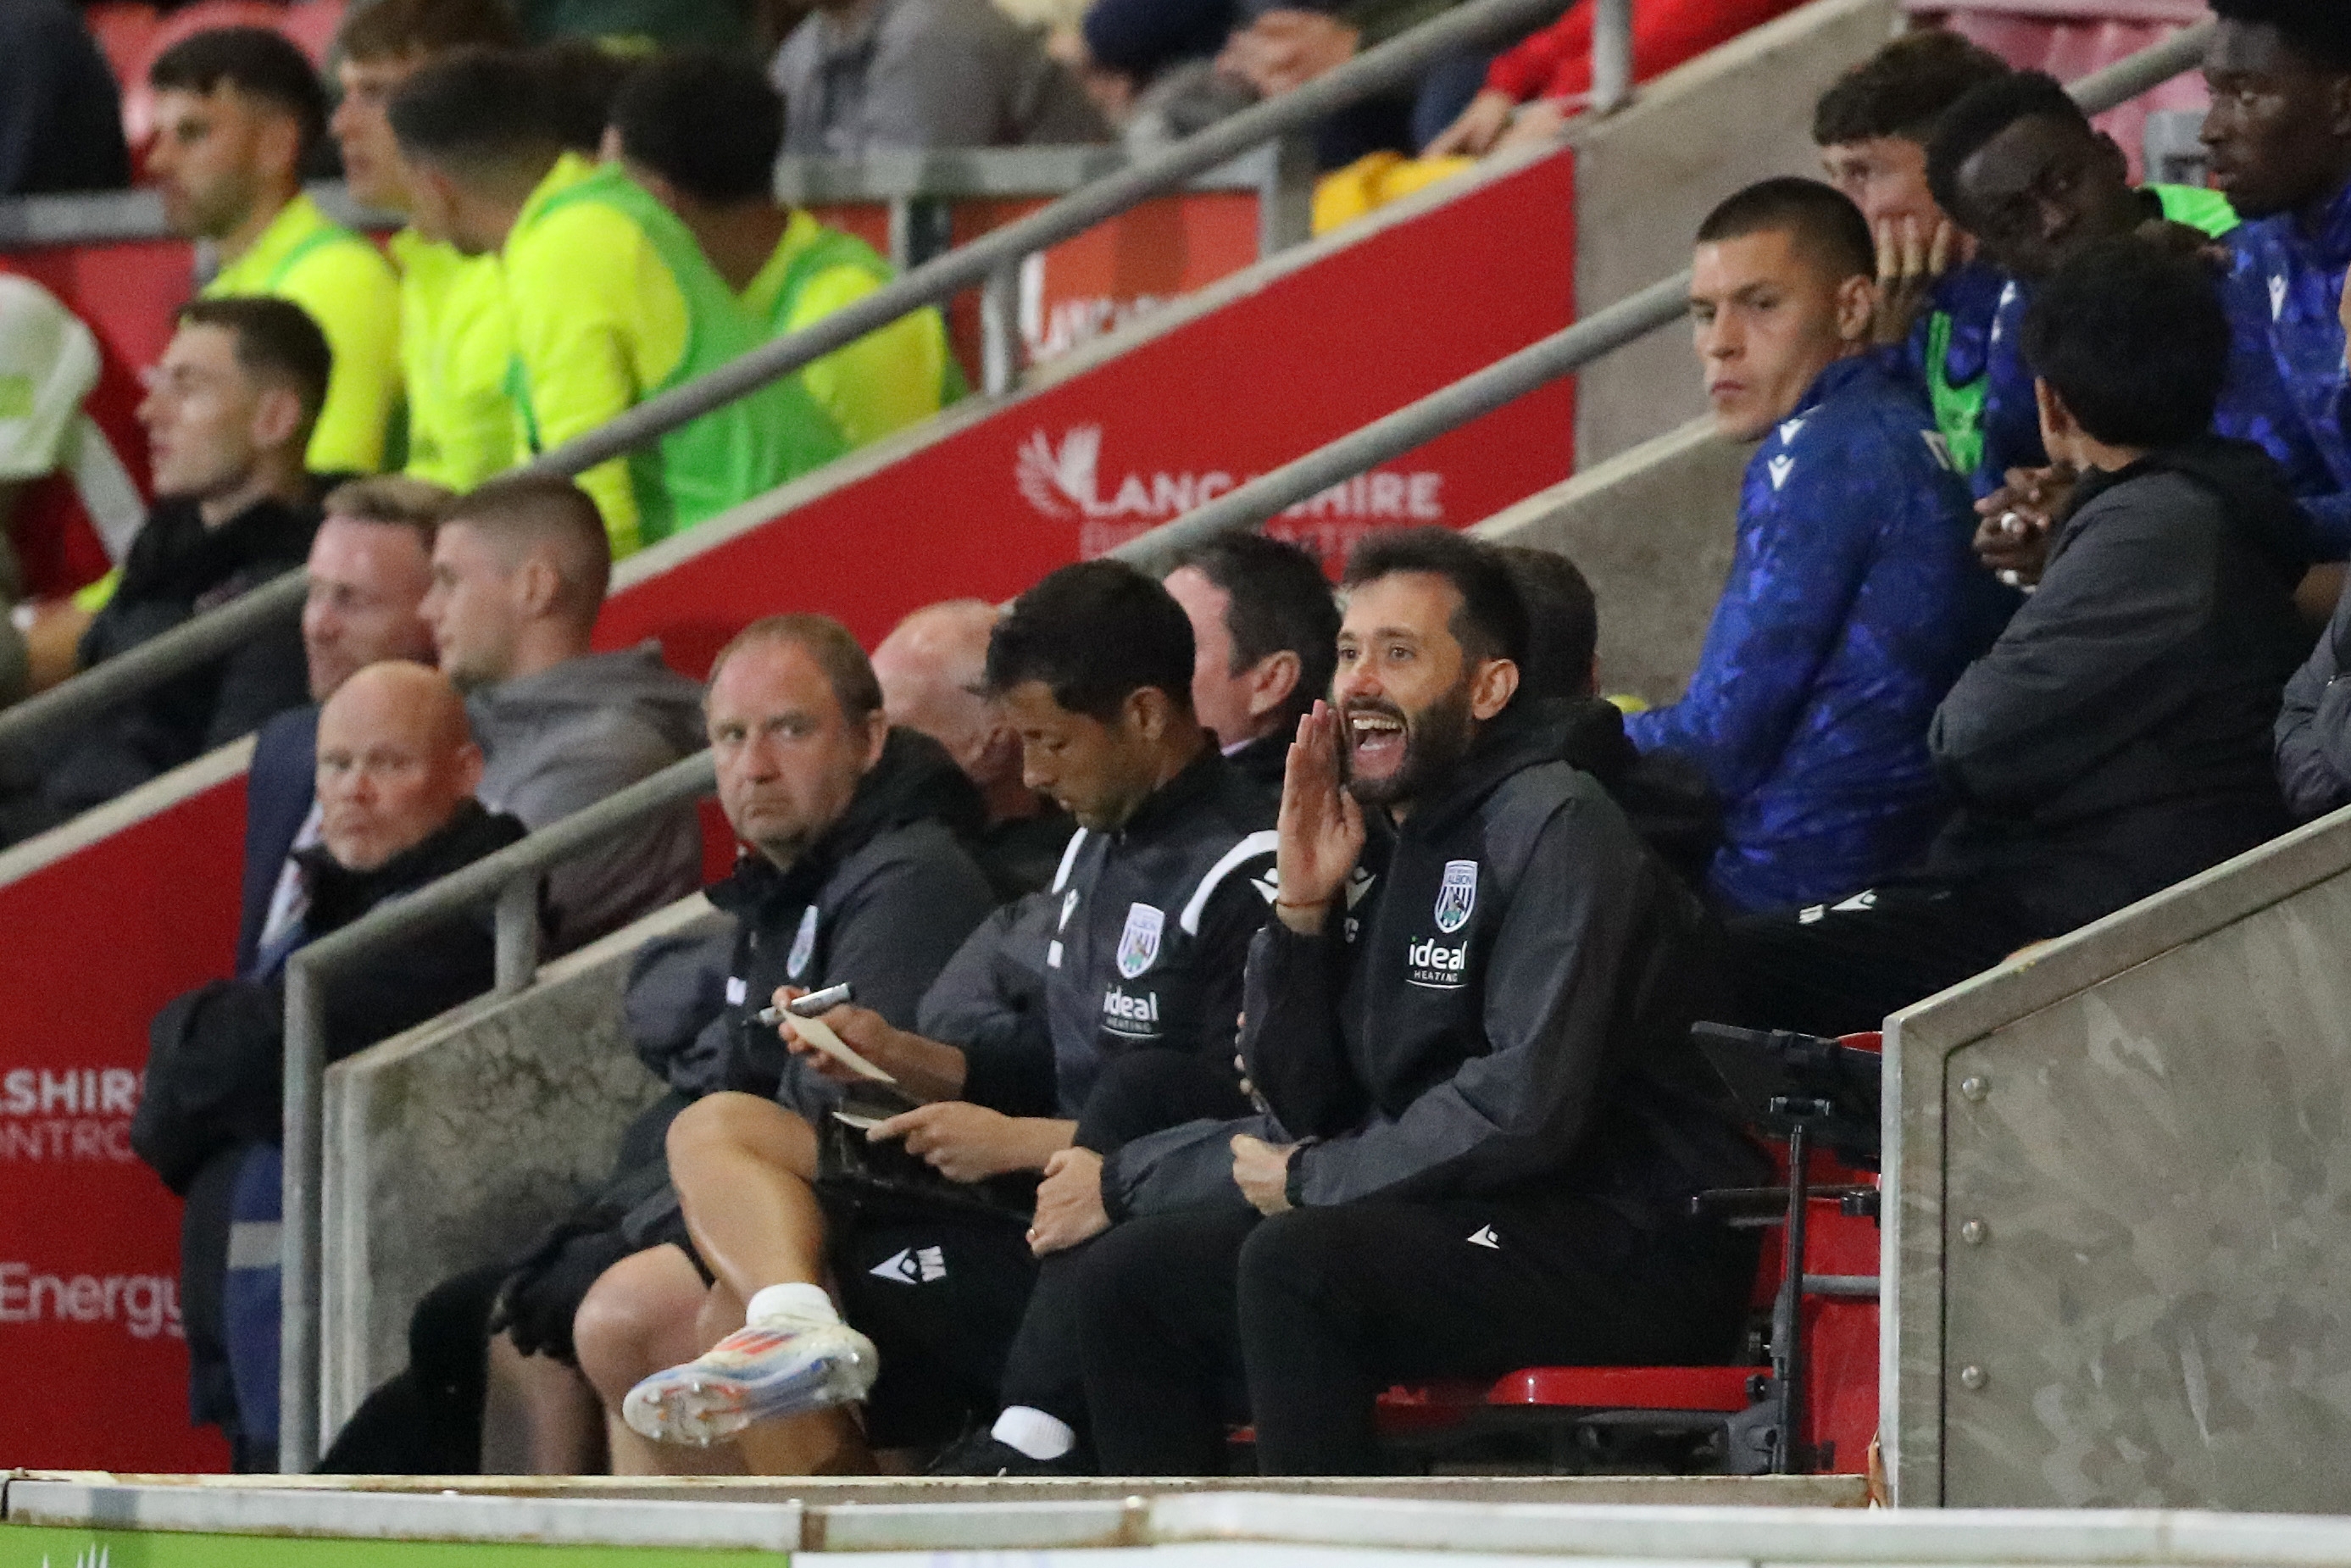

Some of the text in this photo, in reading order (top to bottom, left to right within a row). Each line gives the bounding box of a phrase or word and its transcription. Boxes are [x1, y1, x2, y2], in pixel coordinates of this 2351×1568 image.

[1409, 936, 1468, 970] ideal
[1414, 970, 1459, 983] HEATING
[1103, 981, 1159, 1022] ideal
